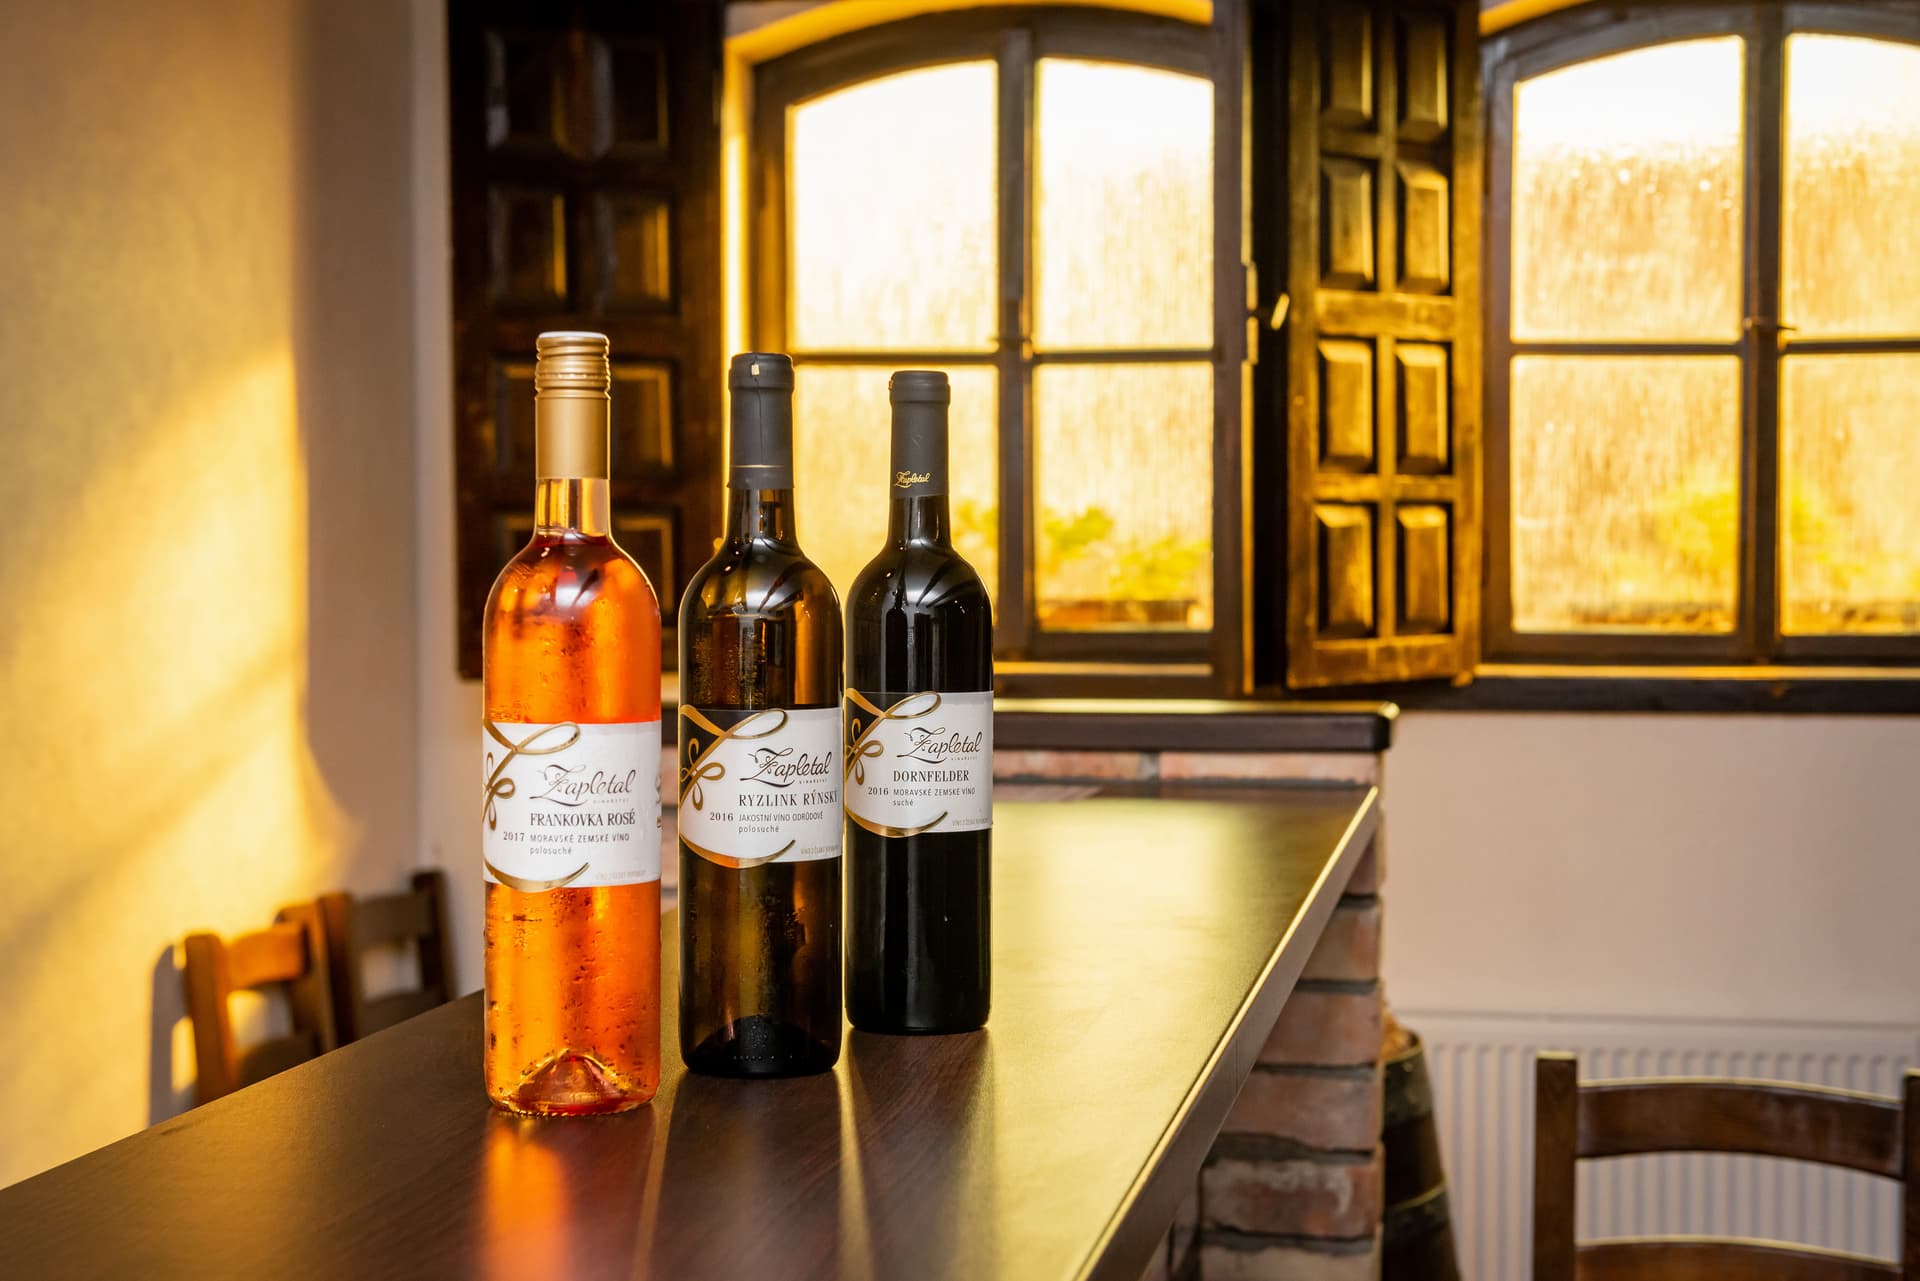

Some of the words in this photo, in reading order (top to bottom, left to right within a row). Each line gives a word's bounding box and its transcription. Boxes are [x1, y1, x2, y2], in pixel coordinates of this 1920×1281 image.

[896, 727, 982, 764] Zapletal
[740, 747, 832, 788] Zapletal
[893, 770, 969, 782] DORNFELDER
[529, 764, 636, 807] Zapletal
[868, 786, 889, 796] 2016
[893, 787, 932, 797] MORAVSKÉ
[935, 787, 960, 796] ZEMSKÉ
[739, 793, 797, 807] RYZLINK
[893, 799, 914, 807] suché
[530, 812, 603, 827] FRANKOVKA
[607, 808, 636, 826] ROSÉ
[710, 811, 734, 822] 2016
[739, 813, 772, 822] JAKOSTNÍ
[773, 813, 790, 822] VÍNO
[738, 825, 780, 834] polosuché
[503, 831, 525, 842] 2017
[530, 833, 573, 843] MORAVSKÉ
[578, 833, 609, 843] ZEMSKÉ
[612, 832, 629, 841] VÍNO
[530, 847, 572, 856] polosuché
